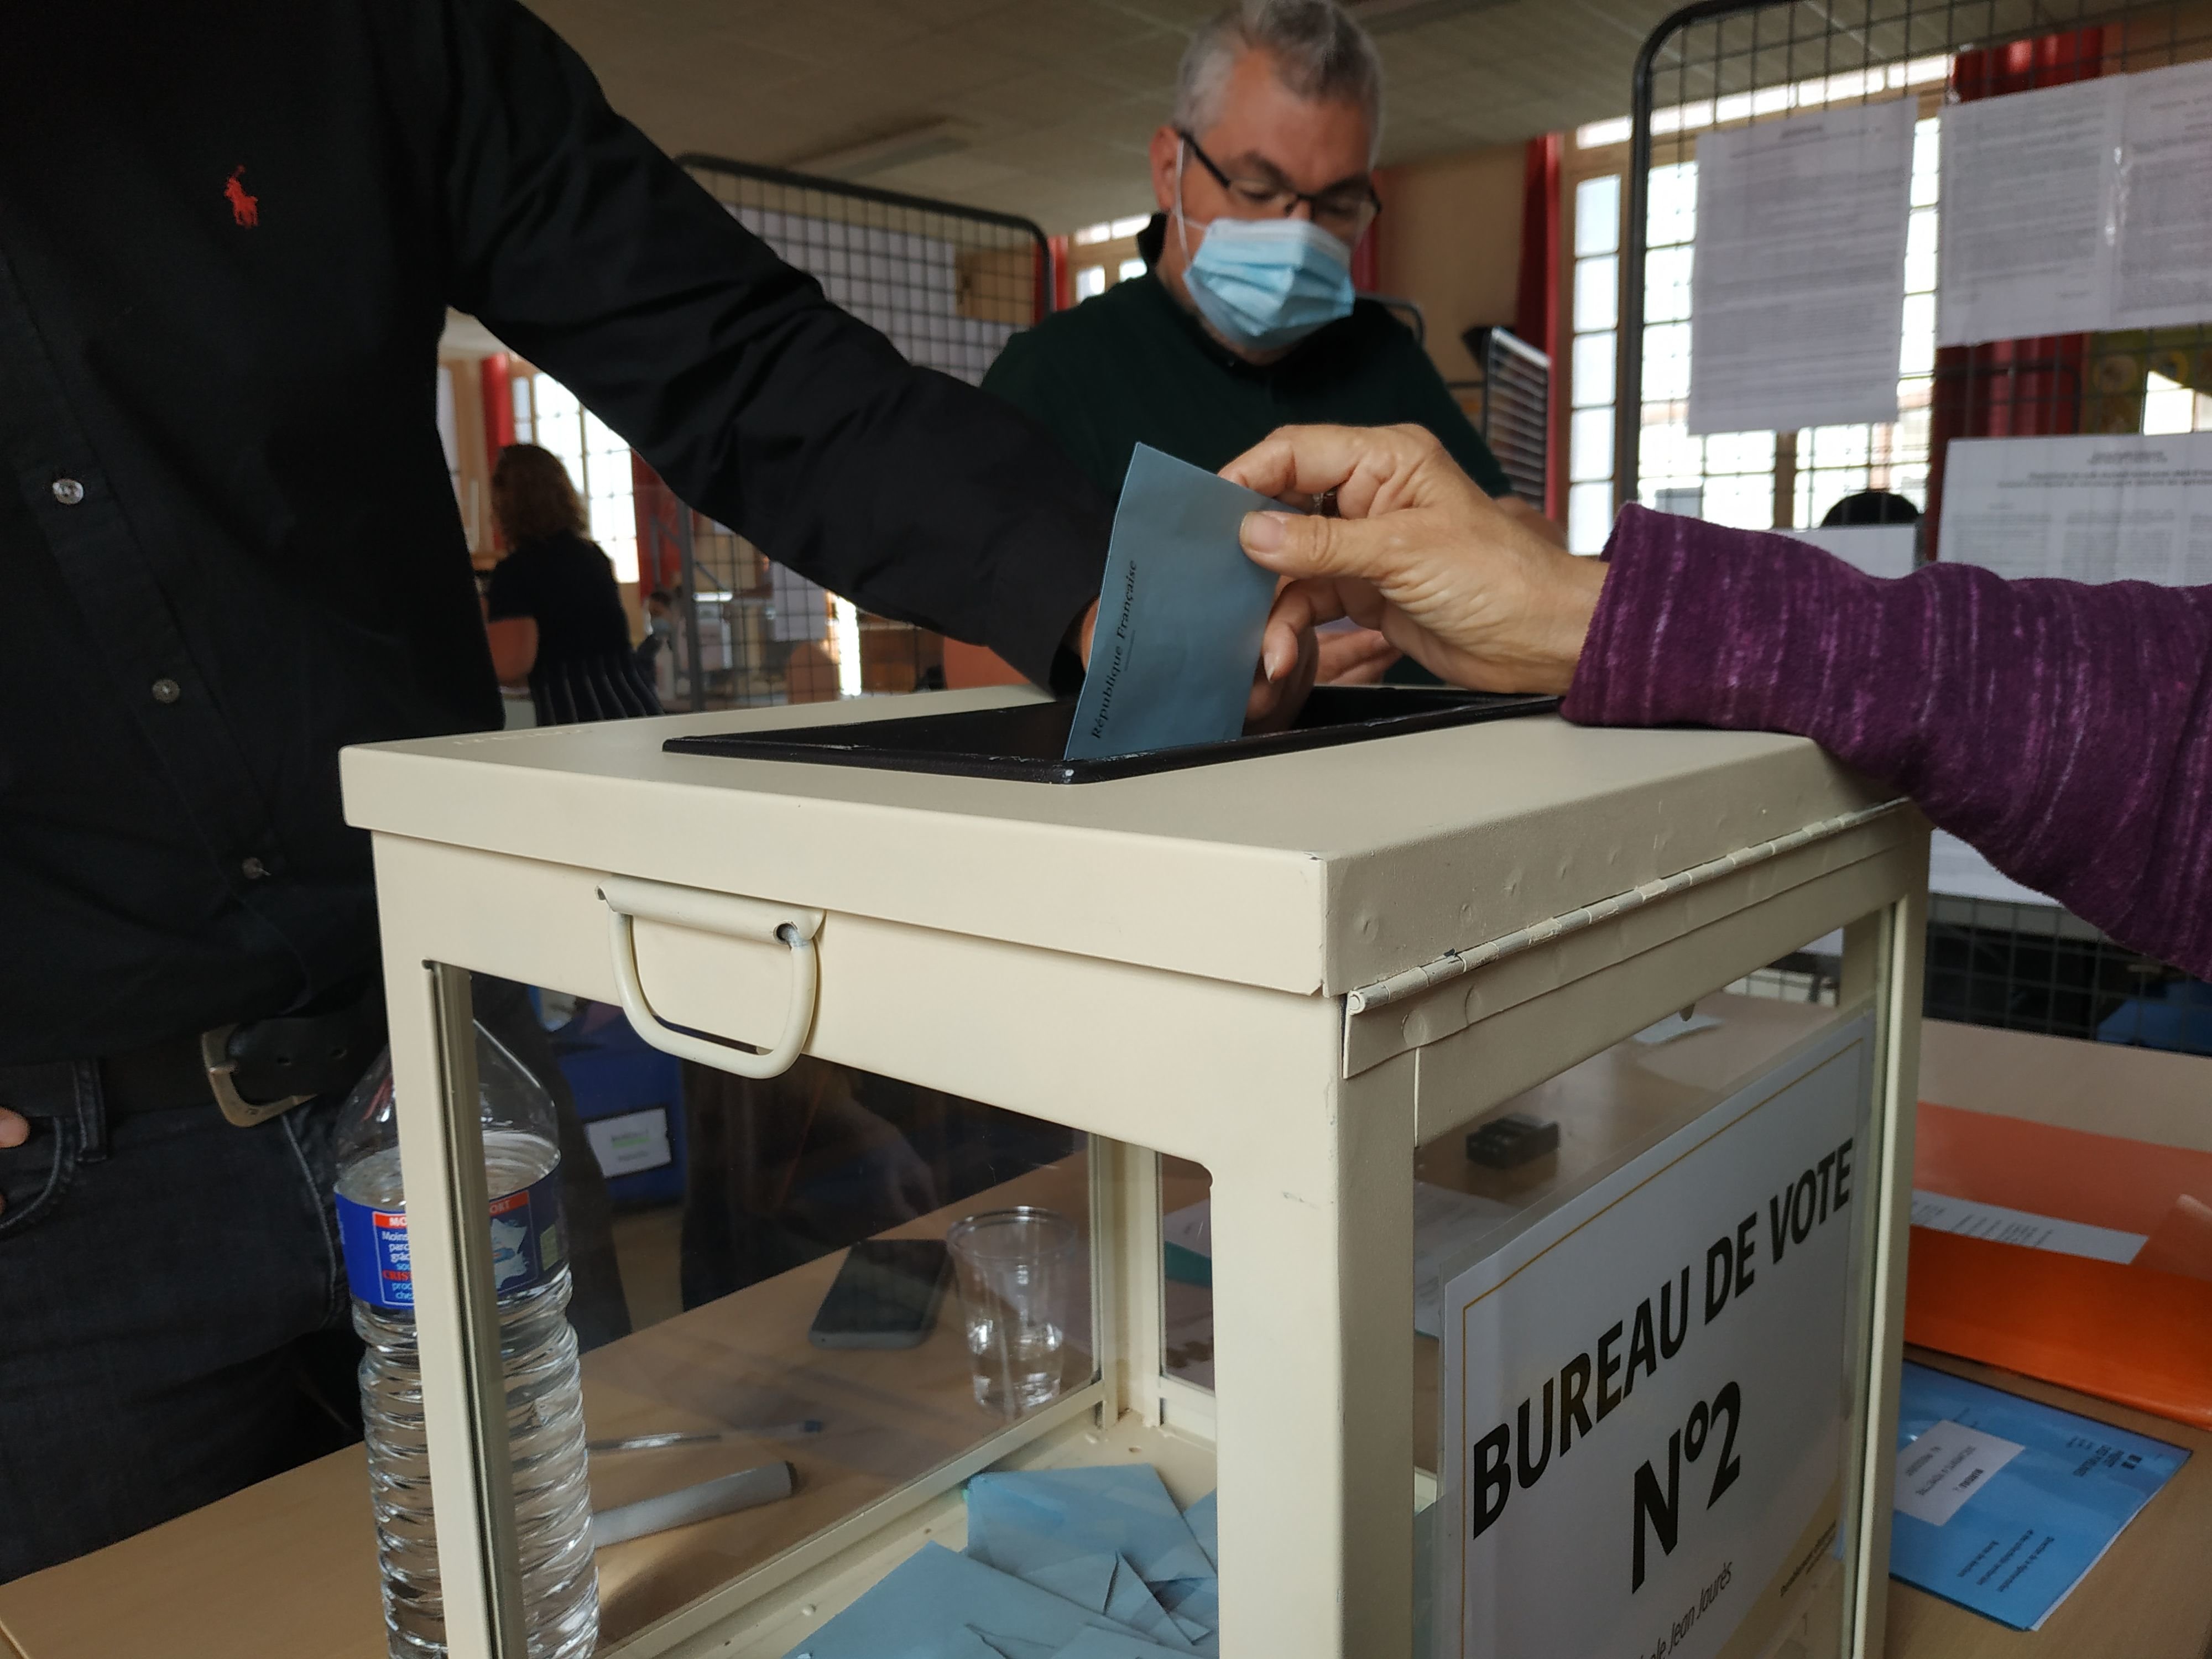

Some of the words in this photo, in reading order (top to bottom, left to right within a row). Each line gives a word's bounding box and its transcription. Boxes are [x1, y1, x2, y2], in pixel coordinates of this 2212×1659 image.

[1091, 646, 1124, 739] République
[1117, 560, 1137, 640] Française
[1473, 1265, 1690, 1540] BUREAU
[1705, 1212, 1757, 1325] DE
[1769, 1138, 1854, 1265] VOTE
[1668, 1606, 1695, 1655] Jean
[1697, 1561, 1733, 1619] Jaurès
